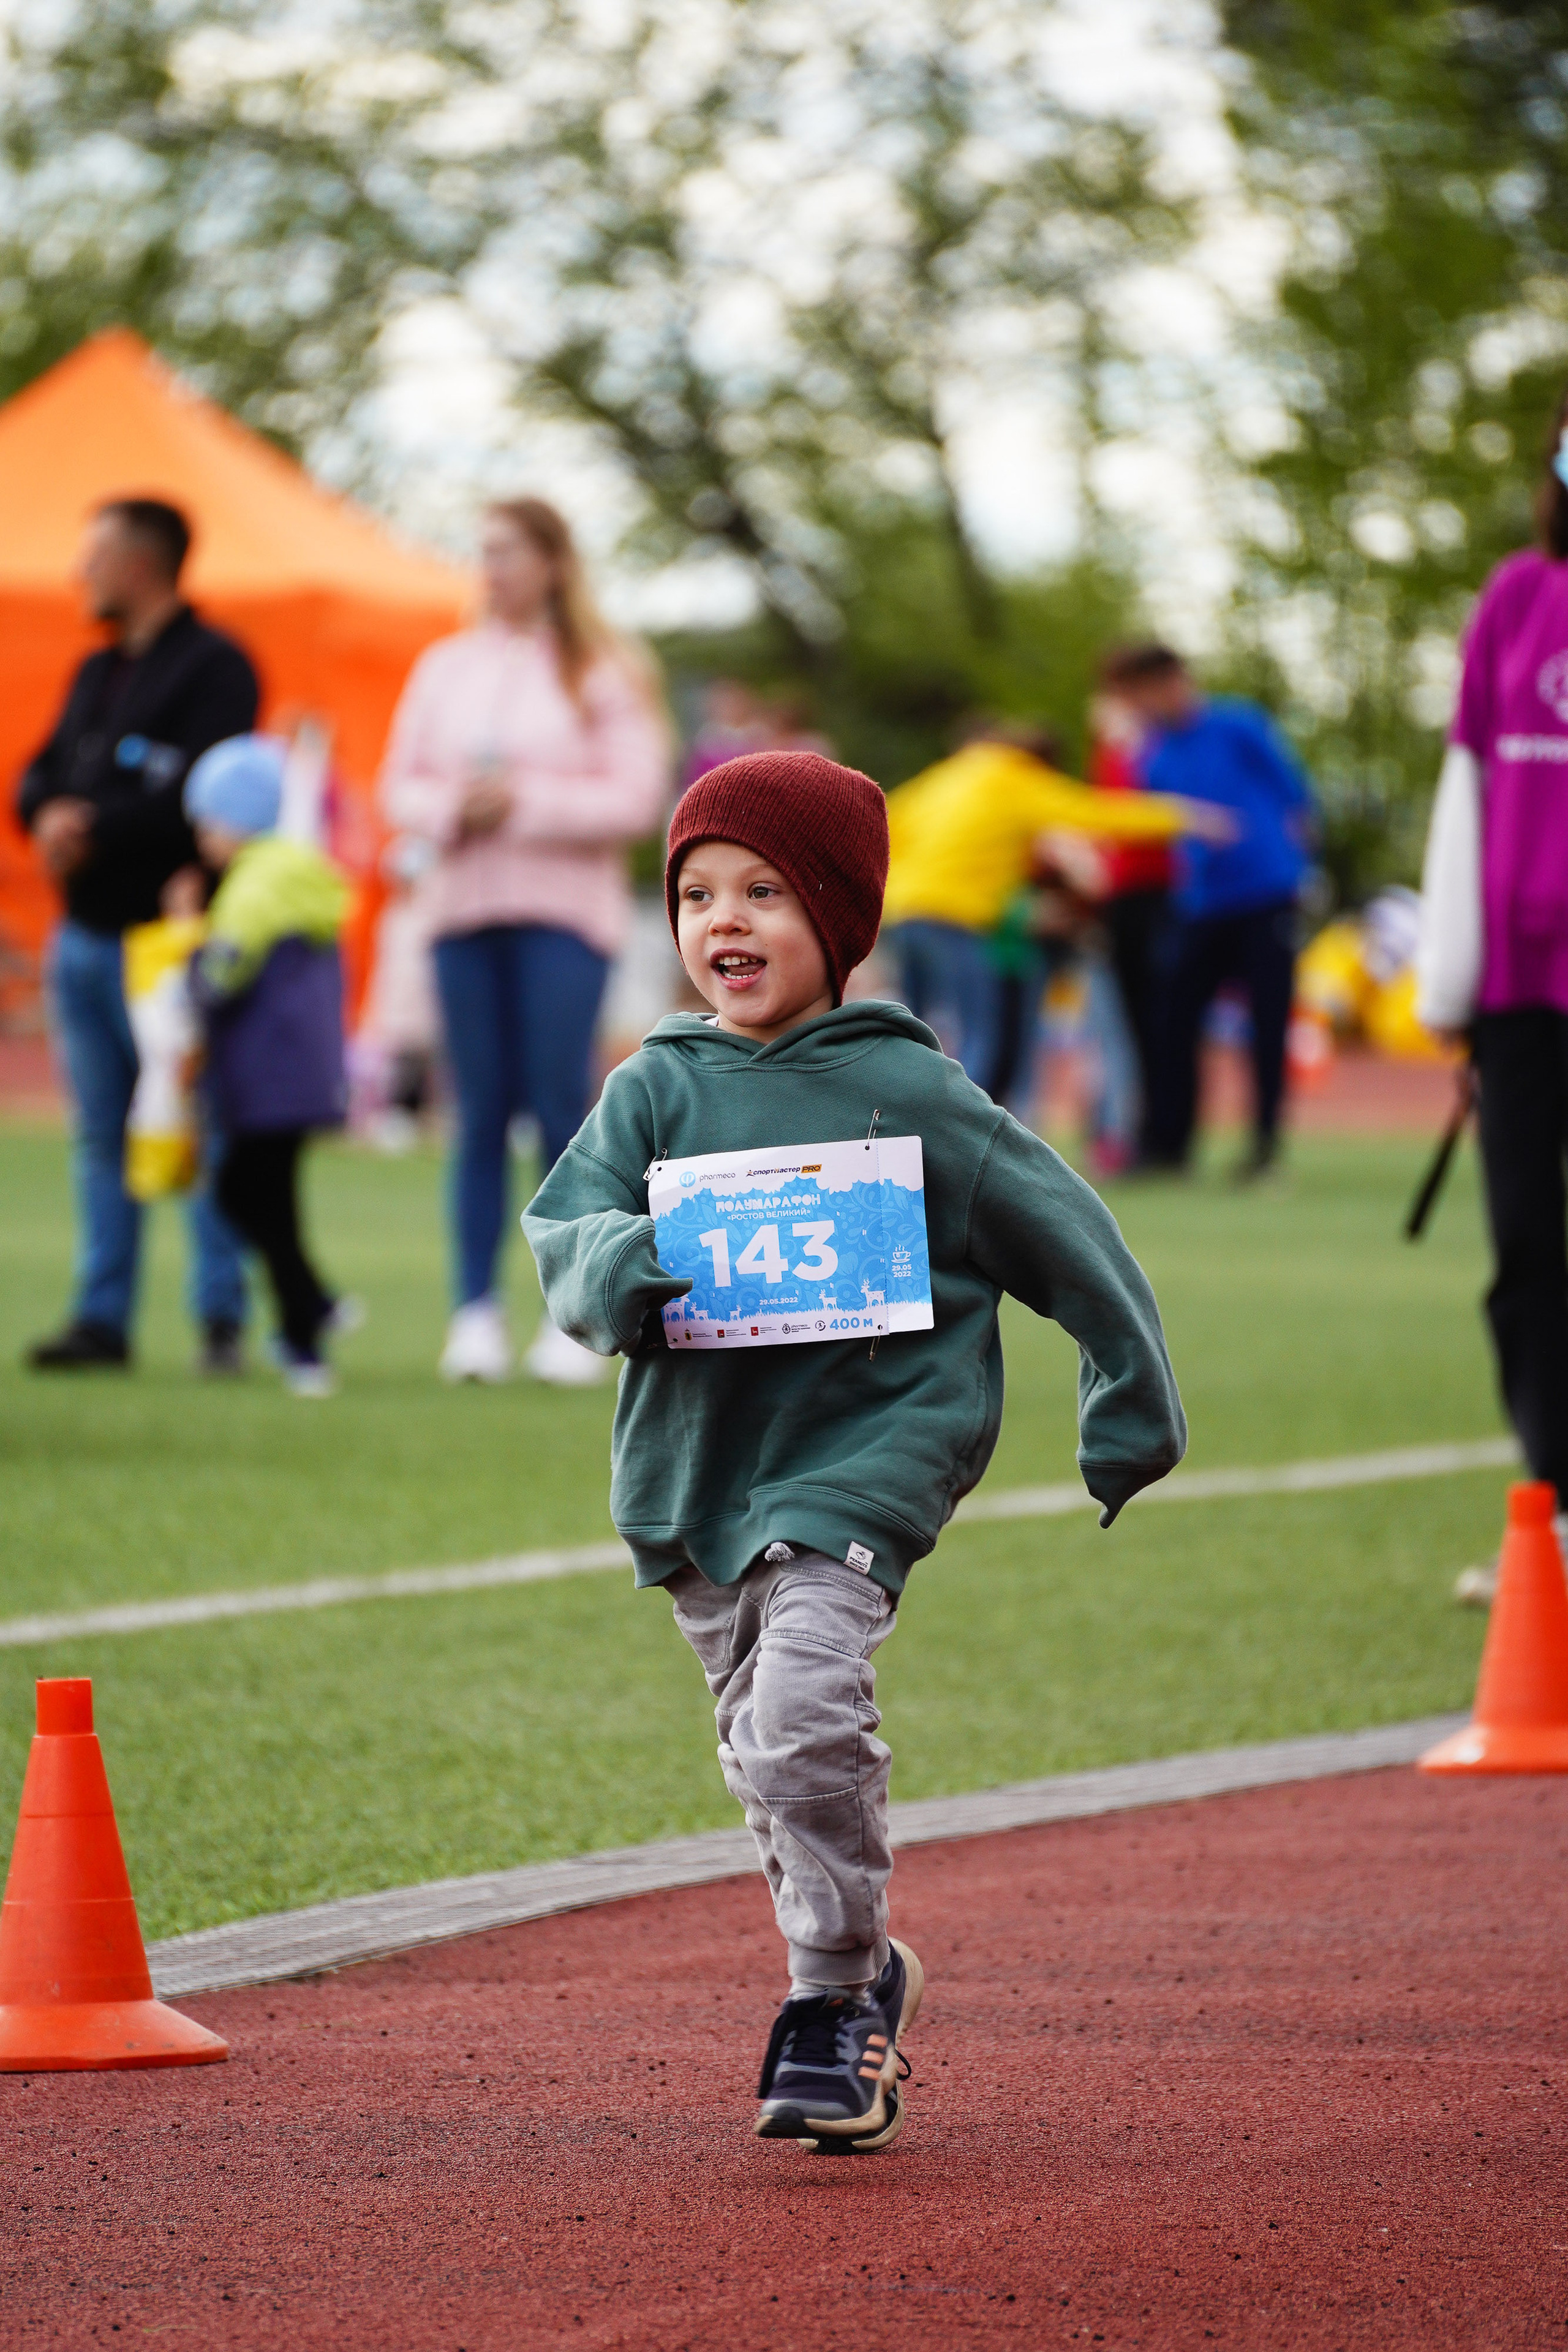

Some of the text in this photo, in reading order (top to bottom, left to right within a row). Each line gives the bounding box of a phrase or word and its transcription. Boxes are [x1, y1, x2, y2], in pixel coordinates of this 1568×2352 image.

[699, 1172, 736, 1182] pharmeco
[715, 1194, 821, 1213] ПОЛУМАРАФОН
[727, 1209, 811, 1221] «РОСТОВ ВЕЛИКИЙ»
[698, 1220, 839, 1287] 143
[760, 1297, 798, 1305] 29.05.2022
[829, 1317, 860, 1330] 400
